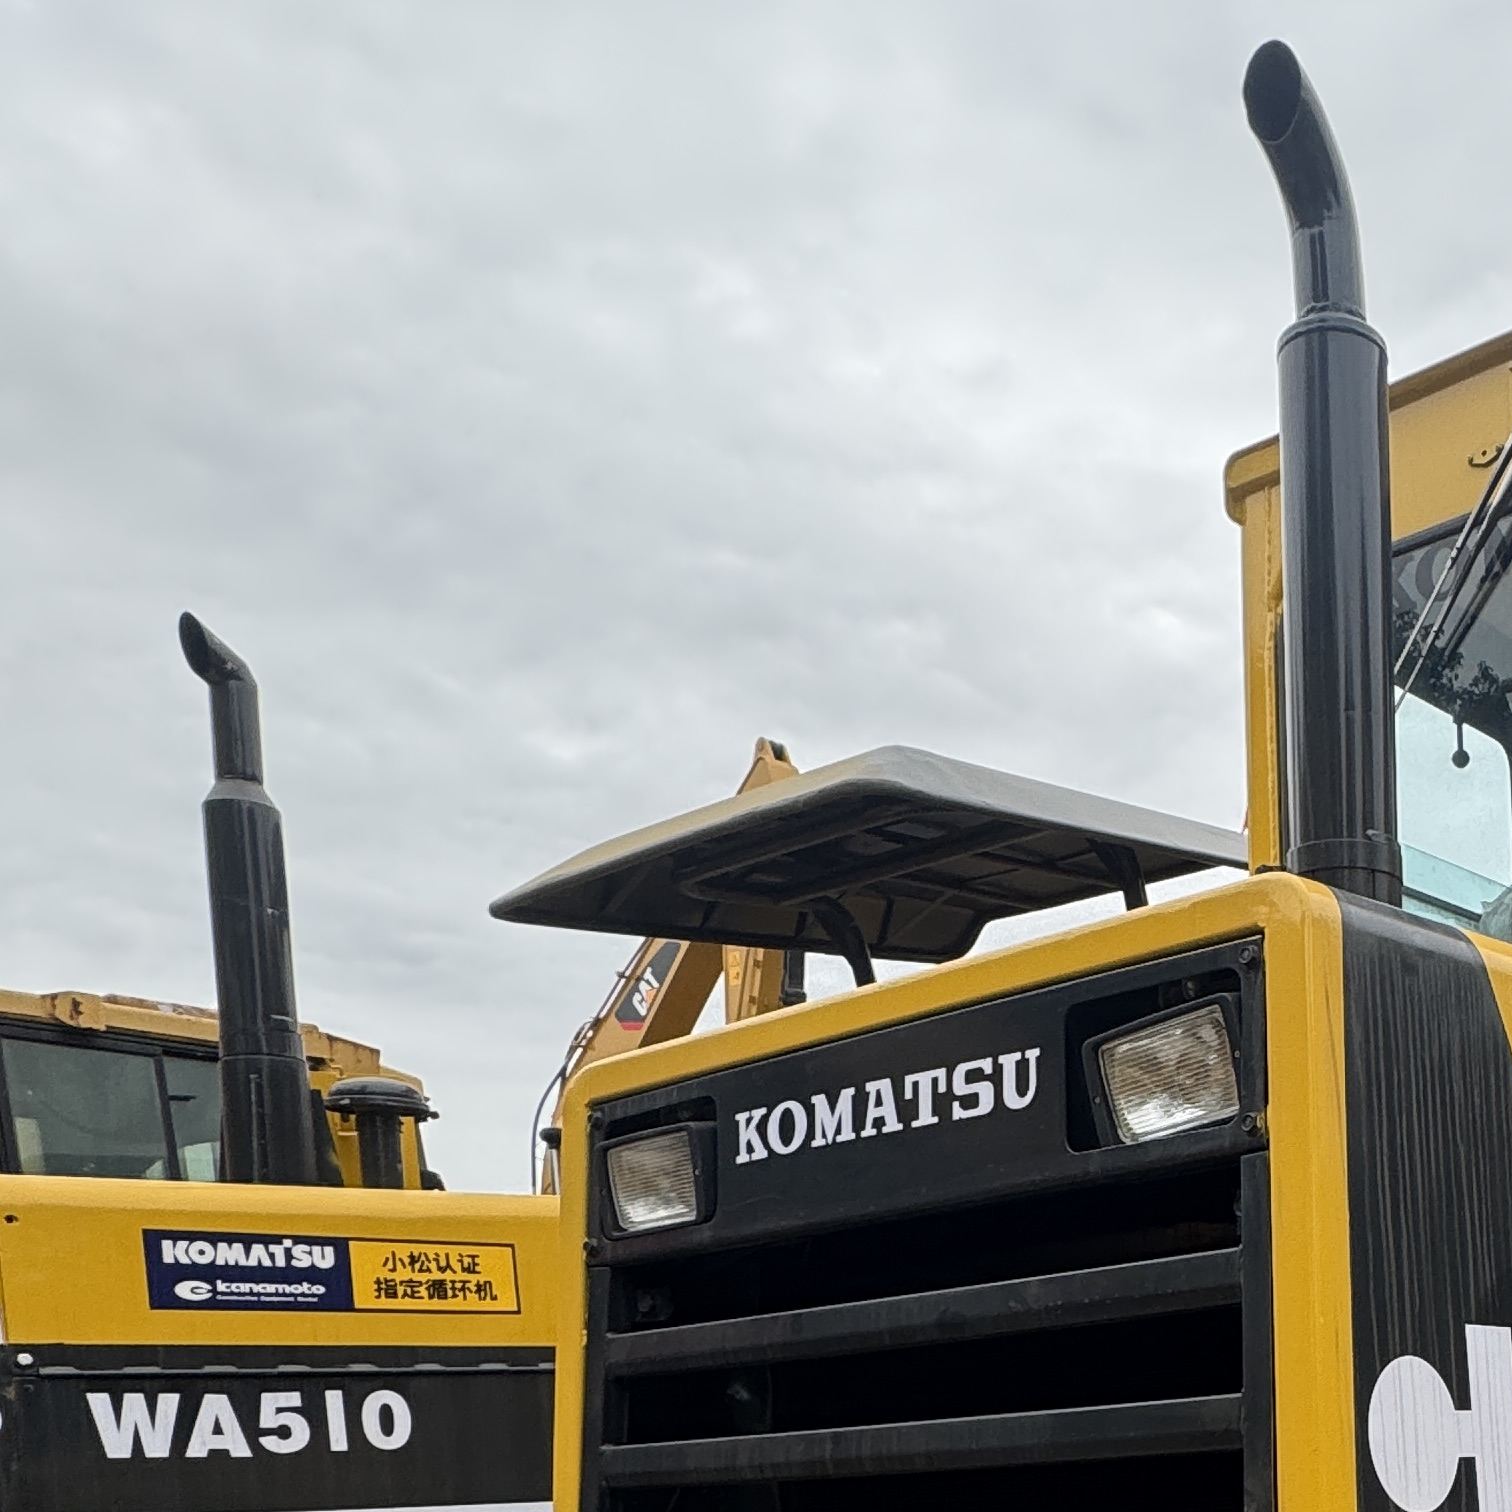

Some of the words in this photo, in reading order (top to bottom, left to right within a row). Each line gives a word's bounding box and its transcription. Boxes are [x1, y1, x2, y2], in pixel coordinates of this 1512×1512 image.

[632, 966, 660, 1017] CAT
[734, 1046, 1041, 1165] KOMATSU
[160, 1238, 335, 1270] KOMATSU
[381, 1249, 482, 1275] 小松认证
[215, 1279, 326, 1295] kanamoto
[373, 1276, 499, 1302] 指定循环机
[85, 1389, 412, 1459] WA510
